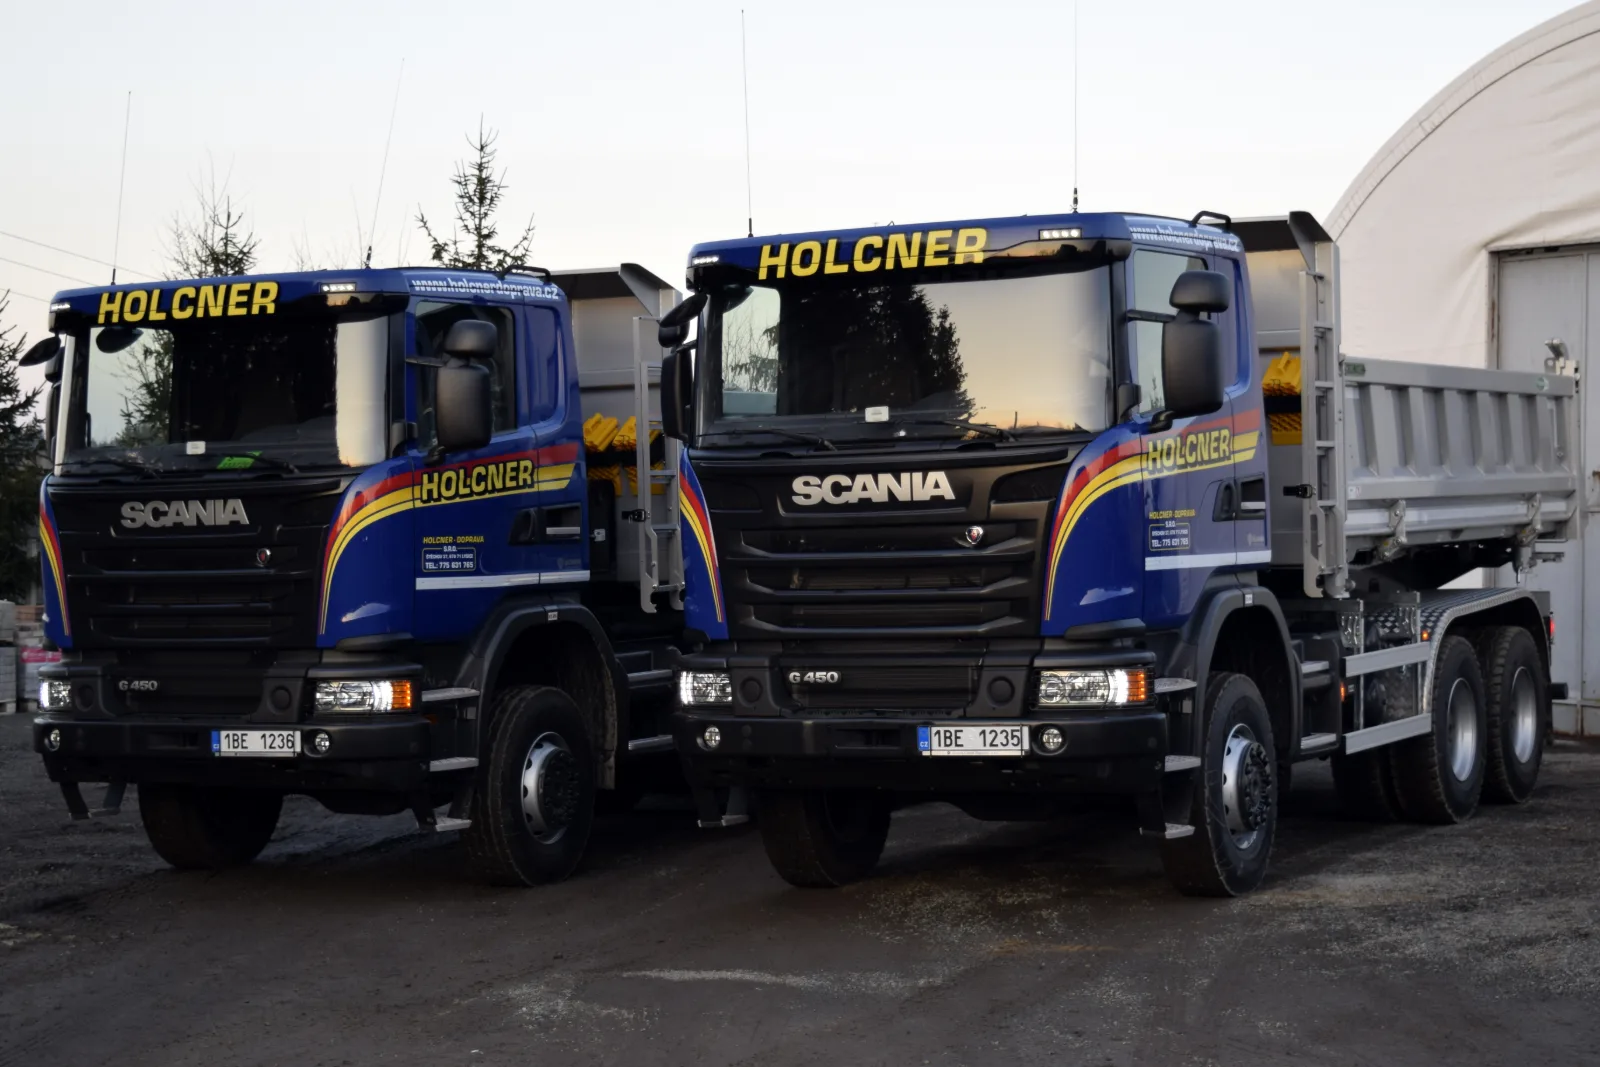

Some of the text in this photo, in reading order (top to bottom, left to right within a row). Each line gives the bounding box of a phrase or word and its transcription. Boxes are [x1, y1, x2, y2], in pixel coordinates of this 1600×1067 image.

[757, 228, 988, 280] HOLCNER
[412, 277, 559, 300] www.holcnerdoprava.cz
[97, 281, 278, 324] HOLCNER
[1147, 429, 1230, 471] HOLCNER
[421, 459, 533, 500] HOLCNER
[791, 471, 956, 506] SCANIA
[120, 498, 250, 528] SCANIA
[1149, 511, 1172, 519] HOLCNER
[118, 680, 158, 691] G 450
[789, 671, 839, 683] G 450
[224, 733, 295, 750] 1BE 1236
[934, 729, 964, 748] 1BE
[979, 729, 1021, 748] 1235
